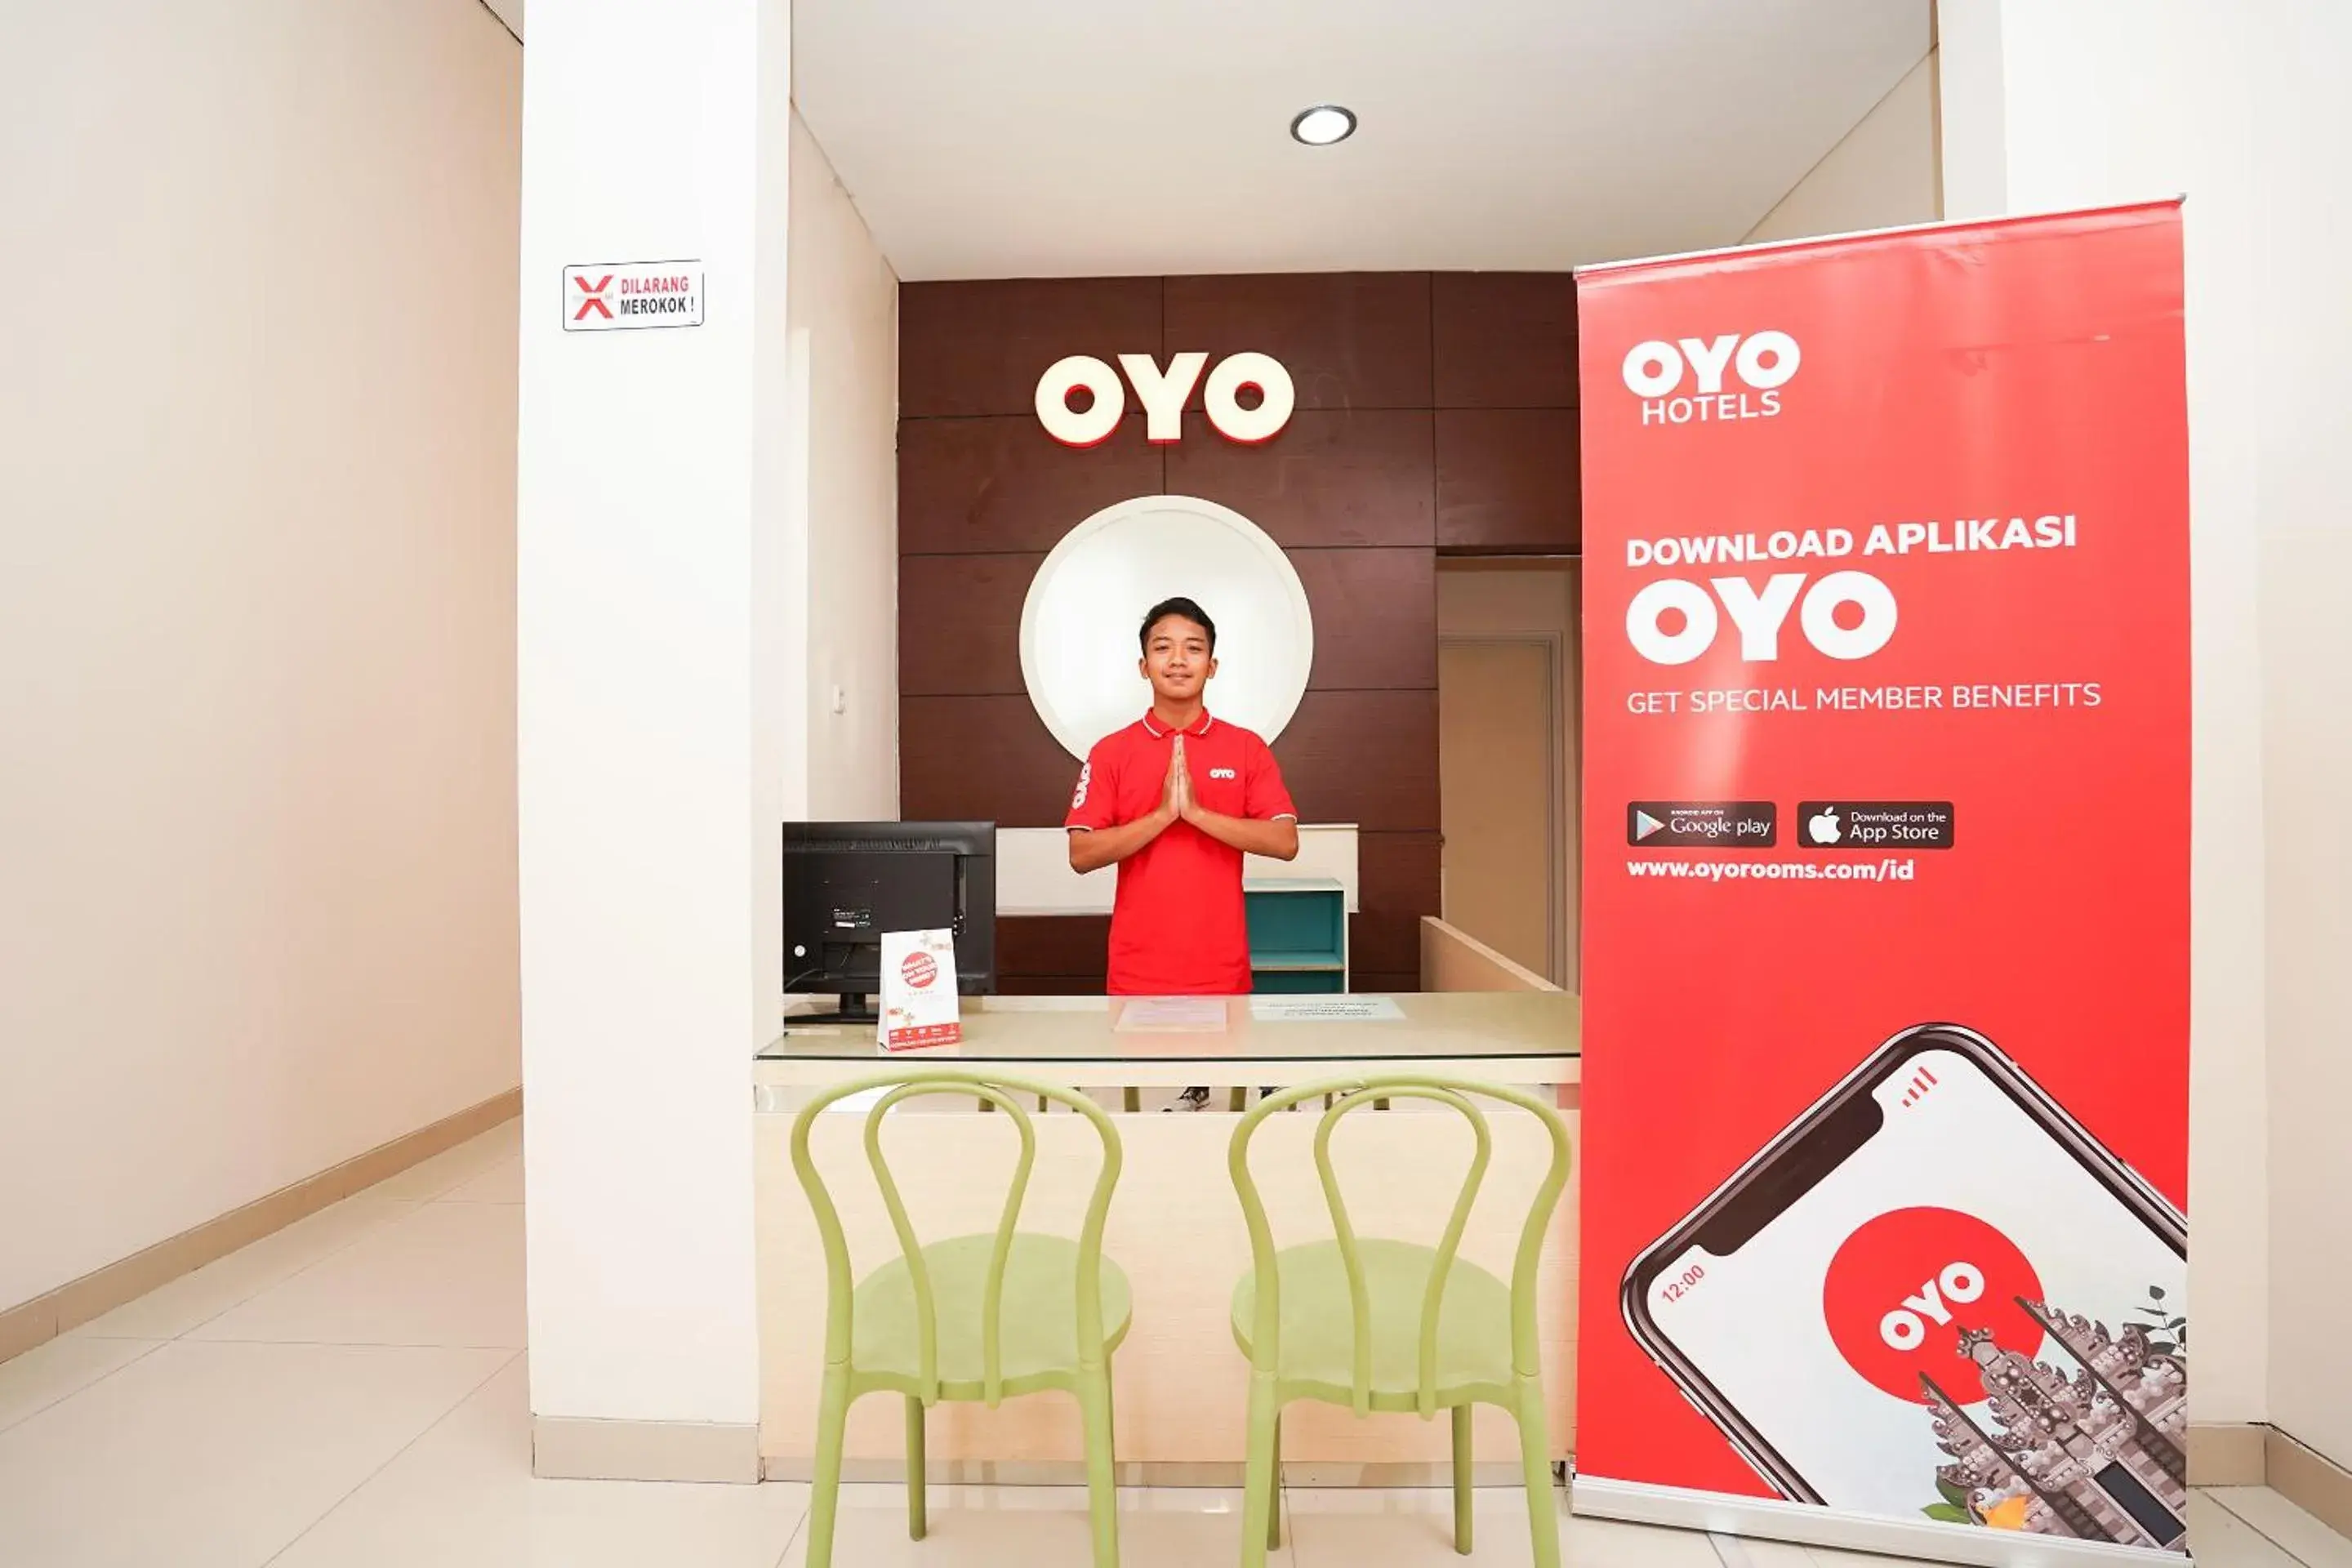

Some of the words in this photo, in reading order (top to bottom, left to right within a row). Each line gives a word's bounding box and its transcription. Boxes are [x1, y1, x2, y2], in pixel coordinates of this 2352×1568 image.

[621, 276, 689, 294] DILARANG
[621, 296, 687, 315] MEROKOK
[1623, 330, 1801, 398] OYO
[1035, 352, 1295, 448] OYO
[1642, 390, 1781, 425] HOTELS
[1627, 528, 1853, 567] DOWNLOAD
[1864, 514, 2076, 556] APLIKASI
[1625, 570, 1898, 666] OYO
[1628, 691, 1682, 714] GET
[1690, 688, 1807, 712] SPECIAL
[1817, 686, 1943, 710] MEMBER
[1953, 683, 2101, 708] BENEFITS
[1209, 768, 1236, 779] OYO
[1670, 817, 1731, 838] Google
[1736, 818, 1771, 836] play
[1851, 812, 1907, 822] Download
[1909, 814, 1925, 822] on
[1927, 812, 1947, 822] the
[1850, 824, 1887, 843] App
[1891, 824, 1940, 840] Store
[1627, 858, 1913, 882] www.oyorooms.com/id
[1662, 1264, 1706, 1304] 12:00
[1879, 1261, 1985, 1351] OYO
